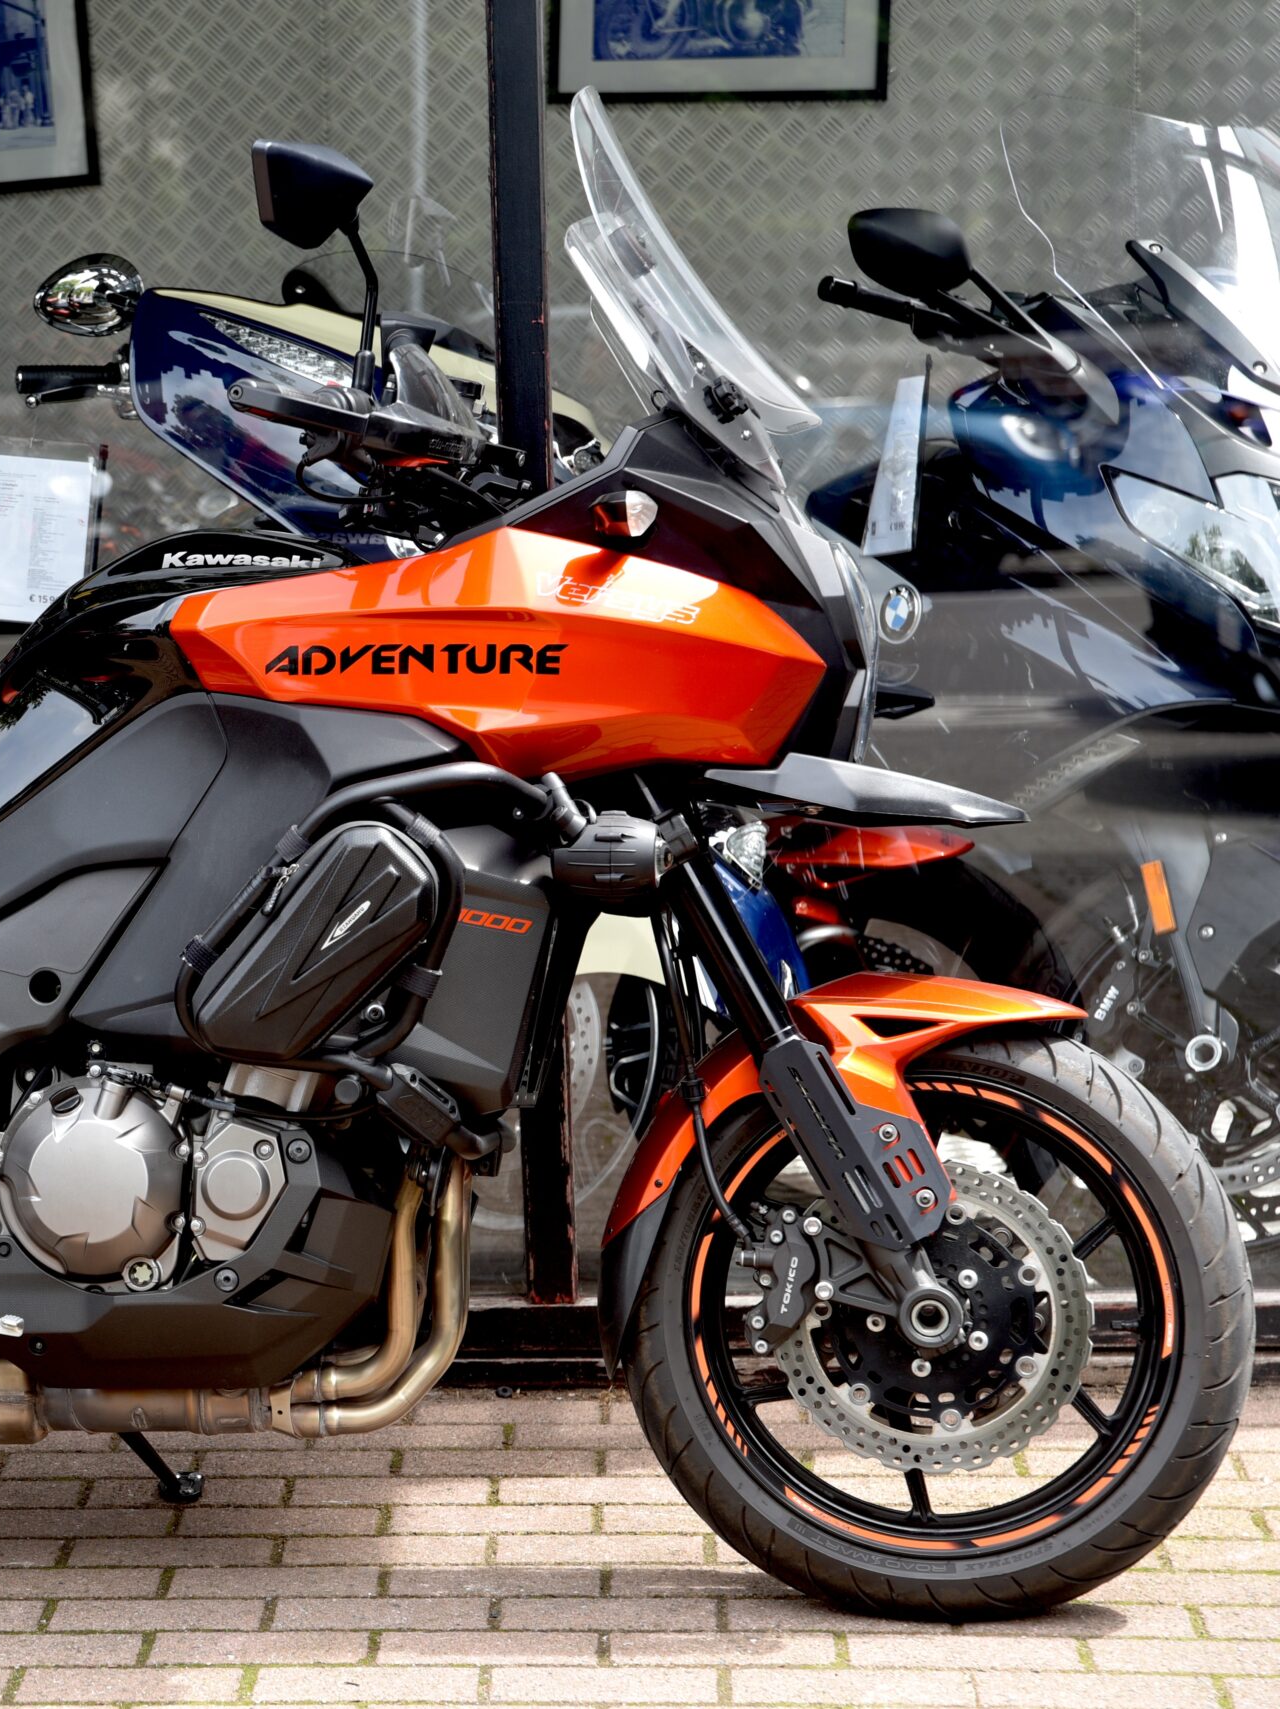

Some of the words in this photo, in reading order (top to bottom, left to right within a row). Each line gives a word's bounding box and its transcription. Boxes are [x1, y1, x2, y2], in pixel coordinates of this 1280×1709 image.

[161, 551, 322, 569] Kawasaki
[265, 643, 569, 676] ADVENTURE
[458, 908, 533, 934] 1000
[1093, 984, 1120, 1021] BMW
[780, 1256, 799, 1315] TOKICO
[965, 1541, 1054, 1574] SPORTMAX
